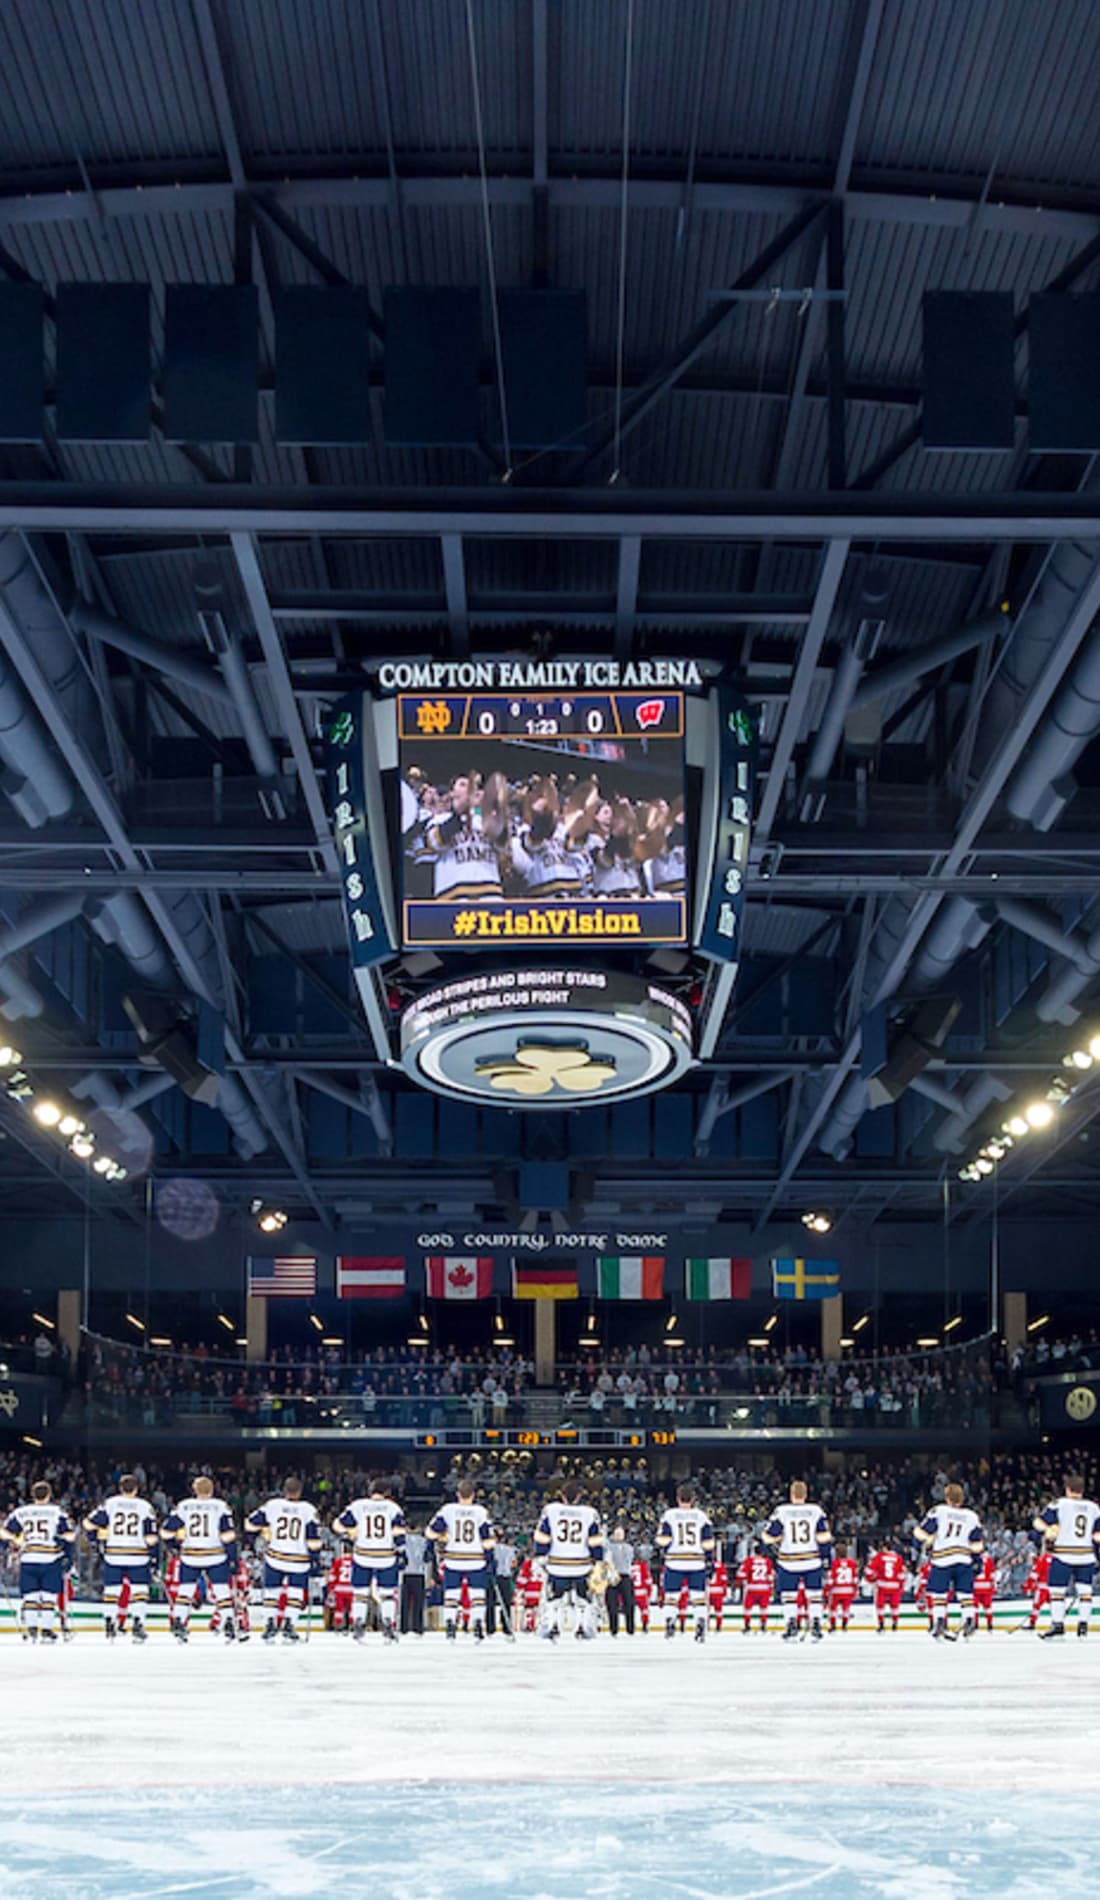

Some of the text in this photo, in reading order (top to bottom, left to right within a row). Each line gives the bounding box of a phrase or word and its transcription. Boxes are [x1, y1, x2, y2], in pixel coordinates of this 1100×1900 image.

[379, 661, 702, 687] COMPTON FAMILY ICE ARENA
[510, 702, 521, 717] 0
[536, 703, 544, 716] 1
[562, 702, 572, 716] 0
[479, 712, 494, 735] 0
[525, 718, 558, 735] 1:23
[587, 711, 602, 733] 0
[454, 908, 642, 936] #IrishVision
[443, 977, 487, 999] STRIPES
[488, 973, 516, 989] AND
[517, 971, 565, 986] BRIGHT
[565, 971, 607, 989] STARS
[470, 991, 530, 1010] PERILOUS
[531, 990, 570, 1004] FIGHT
[24, 1519, 49, 1541] 25
[113, 1511, 140, 1537] 22
[189, 1513, 209, 1538] 21
[276, 1516, 302, 1541] 20
[365, 1514, 385, 1539] 19
[454, 1519, 475, 1543] 18
[556, 1519, 582, 1544] 32
[678, 1522, 696, 1546] 15
[790, 1519, 811, 1544] 13
[1074, 1514, 1088, 1538] 9
[751, 1564, 767, 1581] 22
